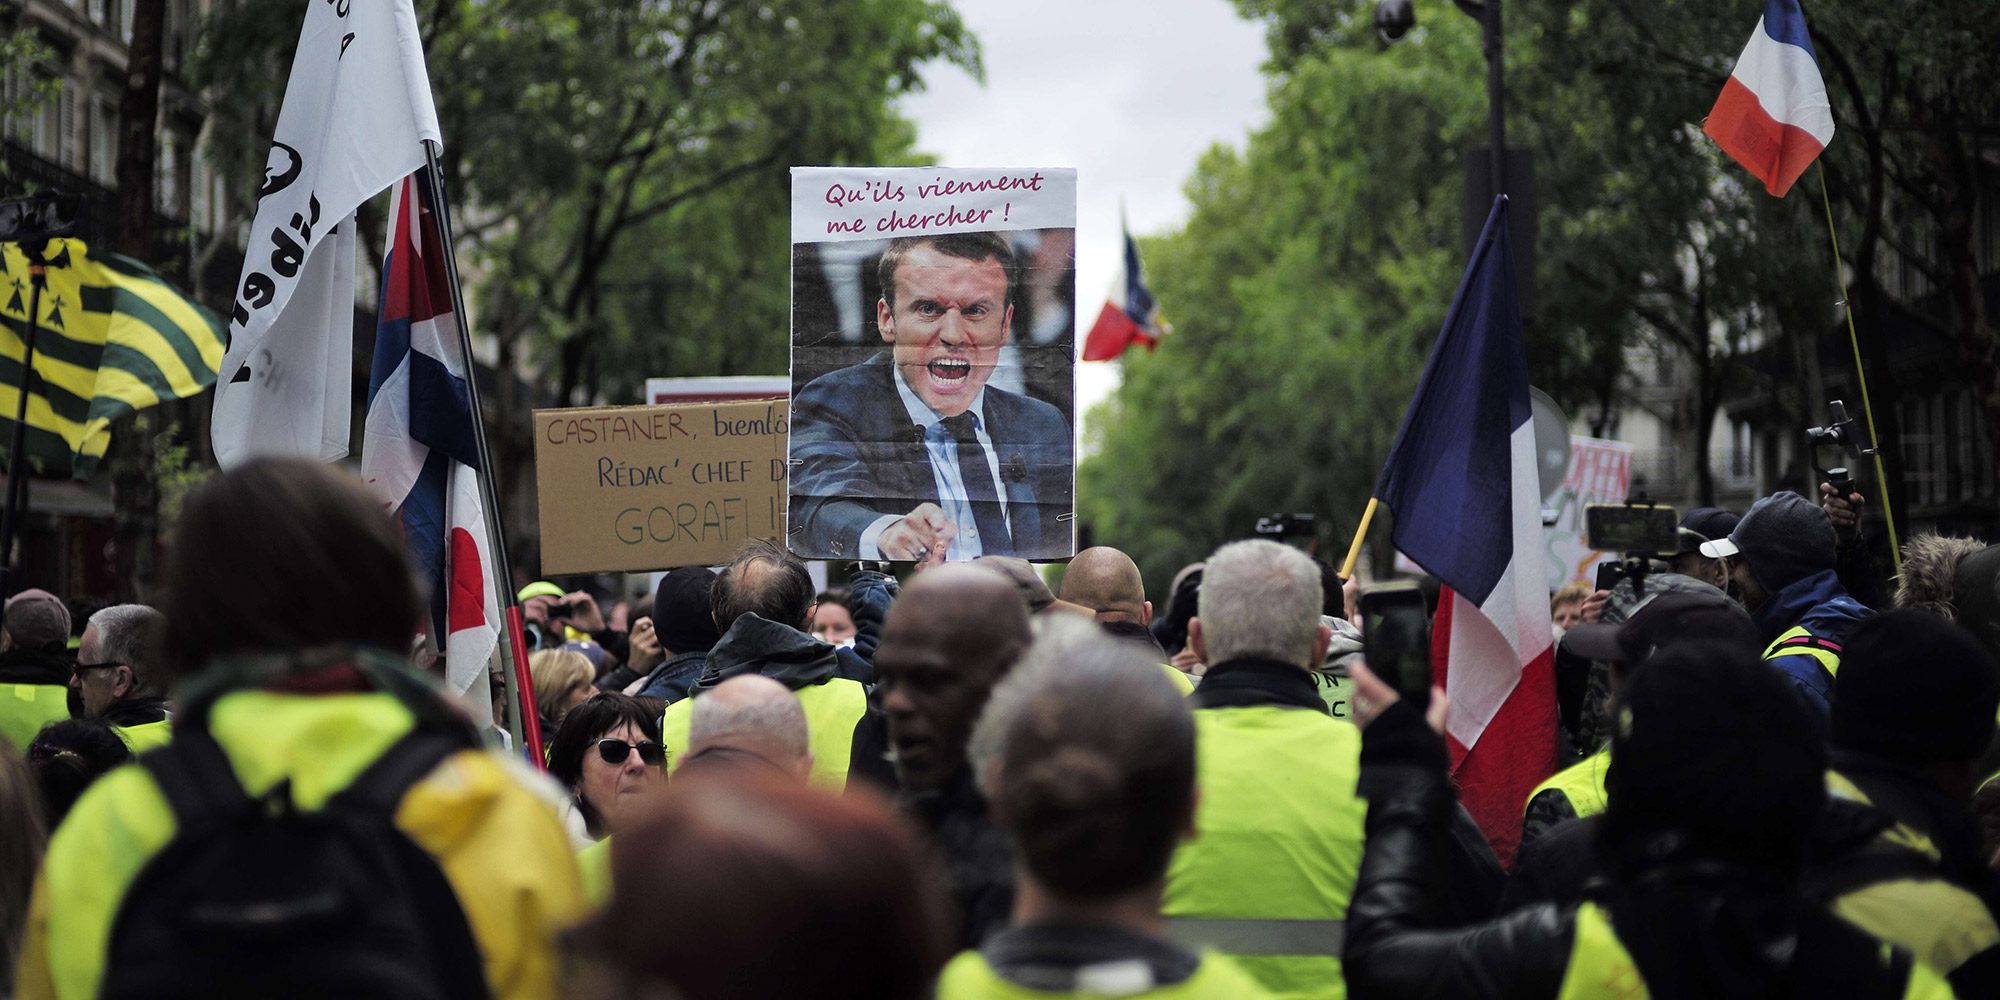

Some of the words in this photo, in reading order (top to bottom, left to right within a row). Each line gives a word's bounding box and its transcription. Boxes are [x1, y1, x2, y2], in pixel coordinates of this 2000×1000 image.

[825, 181, 905, 207] Qu'ils
[918, 172, 1044, 199] viennent
[826, 218, 867, 234] me
[876, 205, 992, 232] chercher
[1003, 202, 1011, 222] !
[547, 412, 698, 445] CASTANER,
[691, 460, 753, 485] CHEF
[770, 458, 787, 482] D
[614, 497, 750, 545] GORAFI
[770, 496, 777, 542] !
